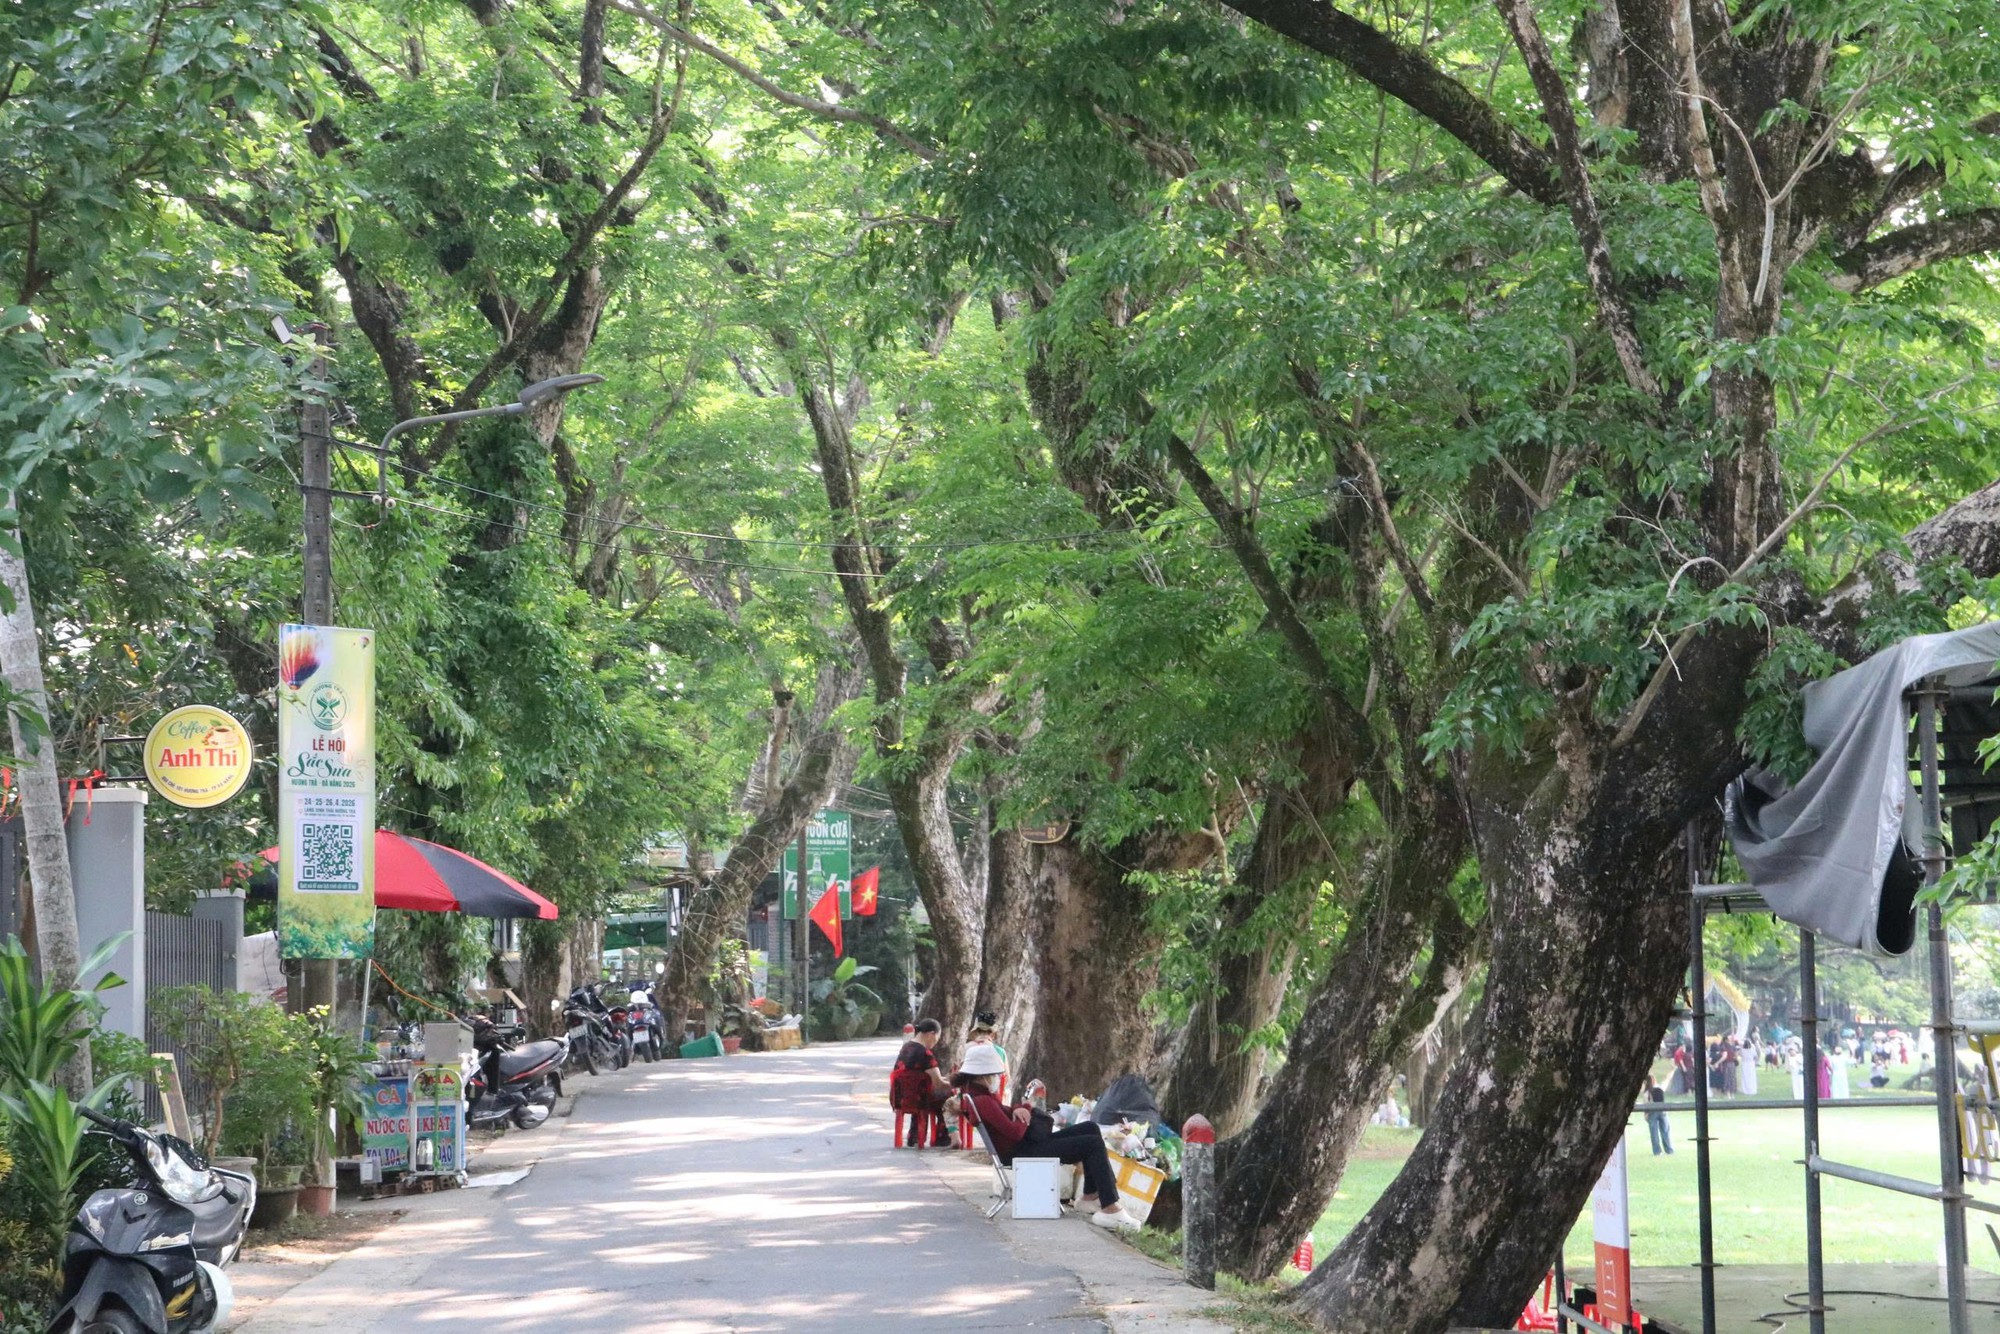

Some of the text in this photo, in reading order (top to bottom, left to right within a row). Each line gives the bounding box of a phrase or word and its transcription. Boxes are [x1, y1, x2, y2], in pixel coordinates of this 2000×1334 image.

[168, 720, 208, 740] Coffee
[312, 734, 346, 755] LỄ HỘI
[158, 748, 237, 767] Anh Thi
